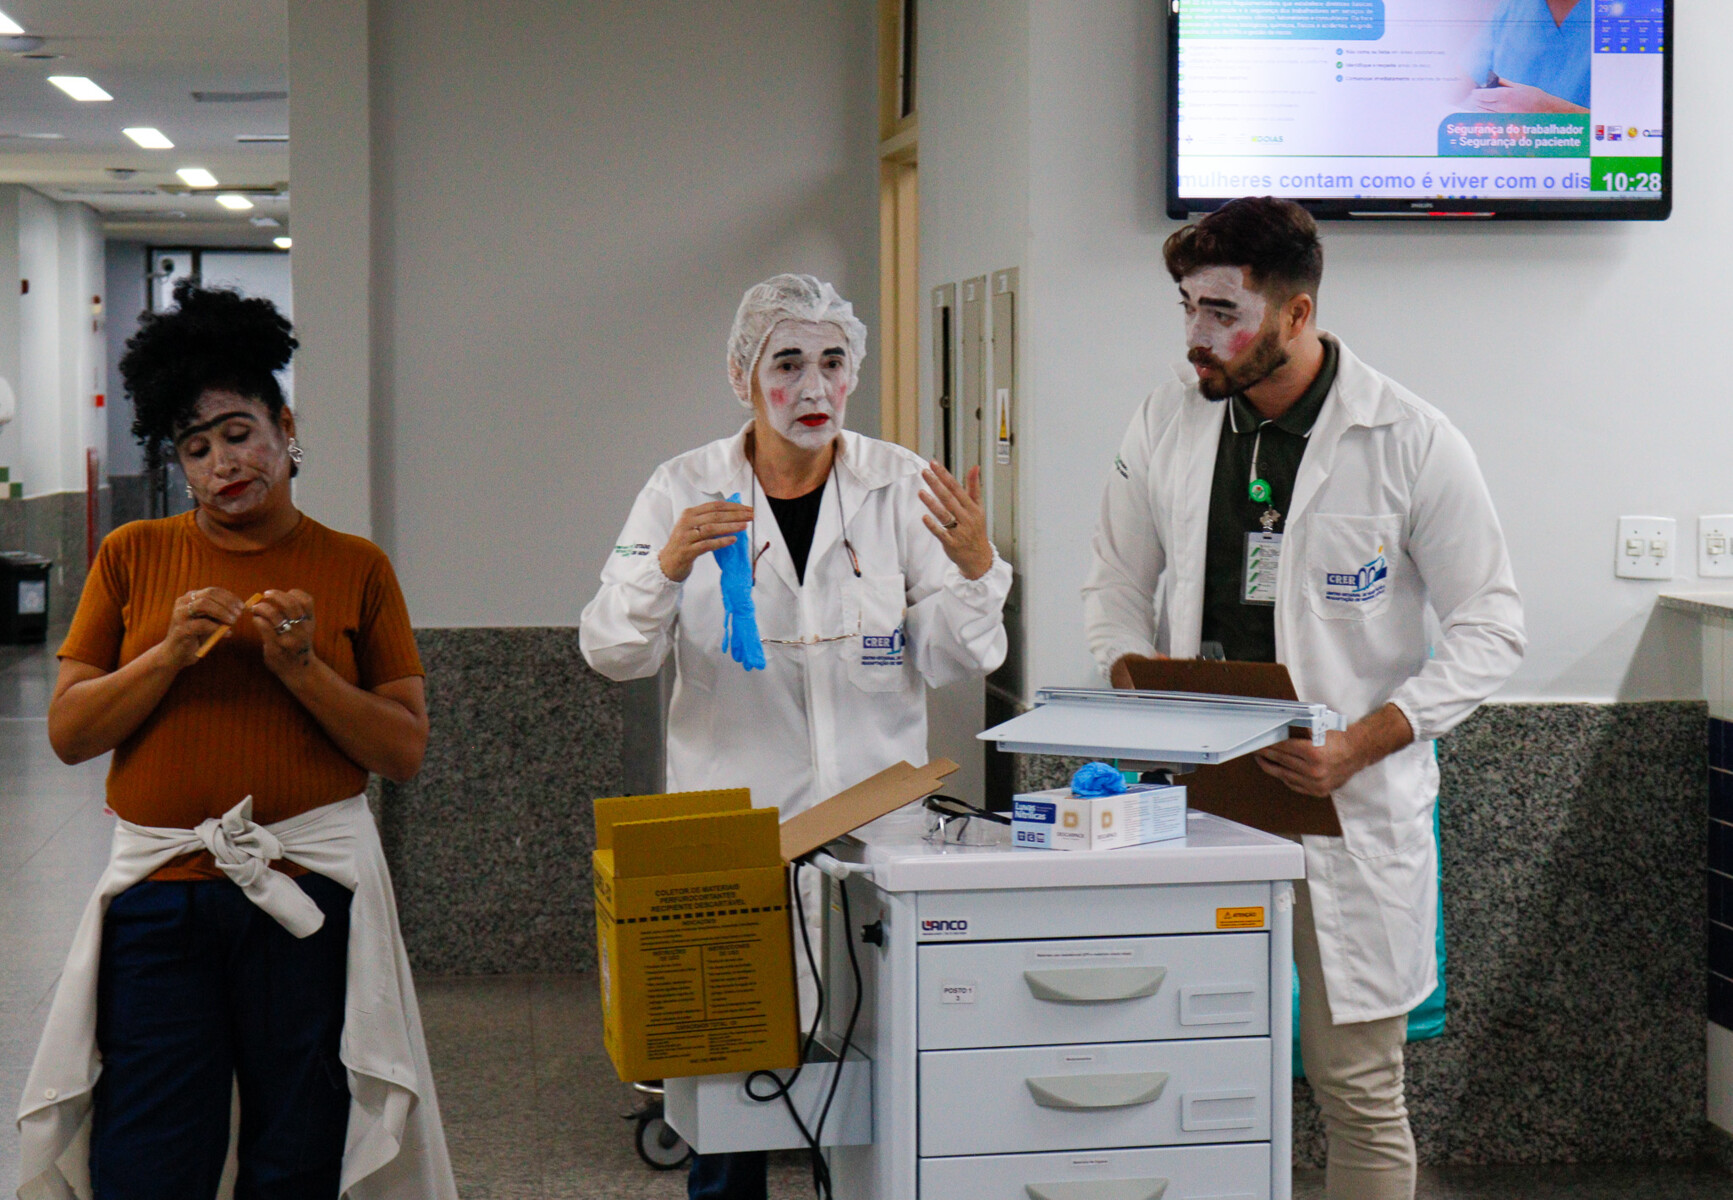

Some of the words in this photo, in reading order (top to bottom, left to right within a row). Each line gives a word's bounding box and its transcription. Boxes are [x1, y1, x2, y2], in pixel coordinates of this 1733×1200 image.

[1446, 124, 1504, 136] Segurança
[1505, 124, 1520, 134] do
[1522, 124, 1585, 135] trabalhador
[1459, 136, 1516, 149] Segurança
[1518, 136, 1533, 147] do
[1534, 136, 1581, 149] paciente
[1179, 172, 1272, 188] mulheres
[1279, 172, 1354, 189] contam
[1360, 175, 1416, 189] como
[1422, 172, 1433, 189] é
[1439, 173, 1489, 189] viver
[1494, 175, 1537, 189] com
[1543, 175, 1556, 189] o
[1562, 172, 1591, 189] dis
[1602, 172, 1663, 191] 10:28
[1328, 575, 1357, 585] CRER
[864, 637, 891, 647] CRER
